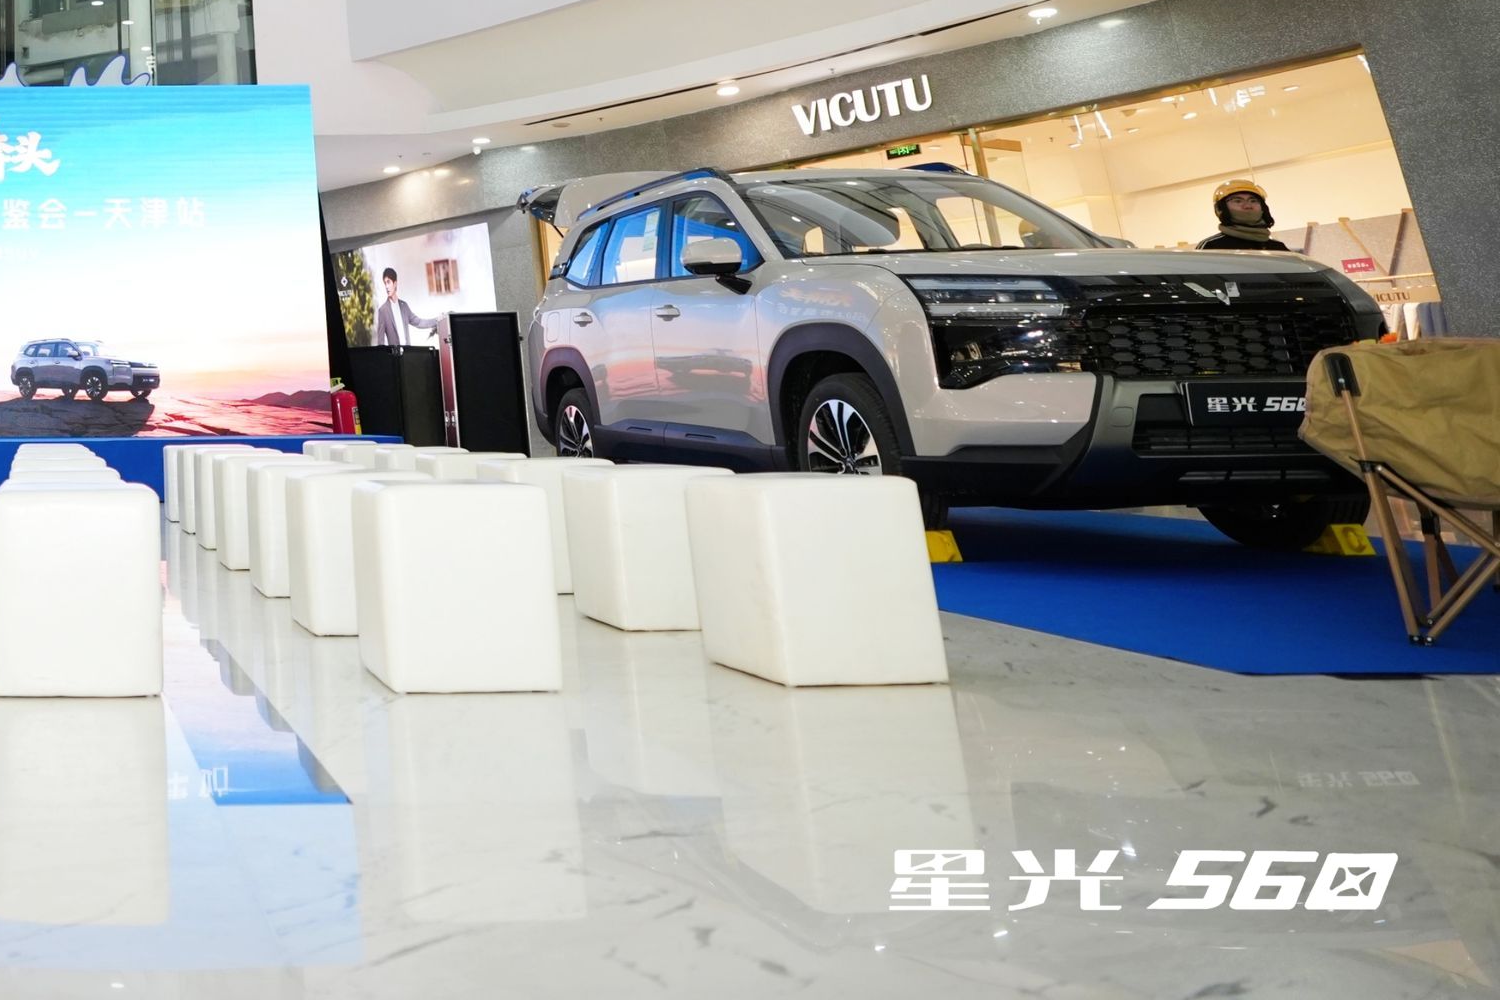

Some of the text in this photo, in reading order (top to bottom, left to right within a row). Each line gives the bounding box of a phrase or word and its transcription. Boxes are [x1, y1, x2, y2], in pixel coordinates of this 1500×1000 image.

[791, 74, 933, 137] VICUTU
[1374, 290, 1411, 303] ICUTU
[1206, 396, 1257, 413] 星光
